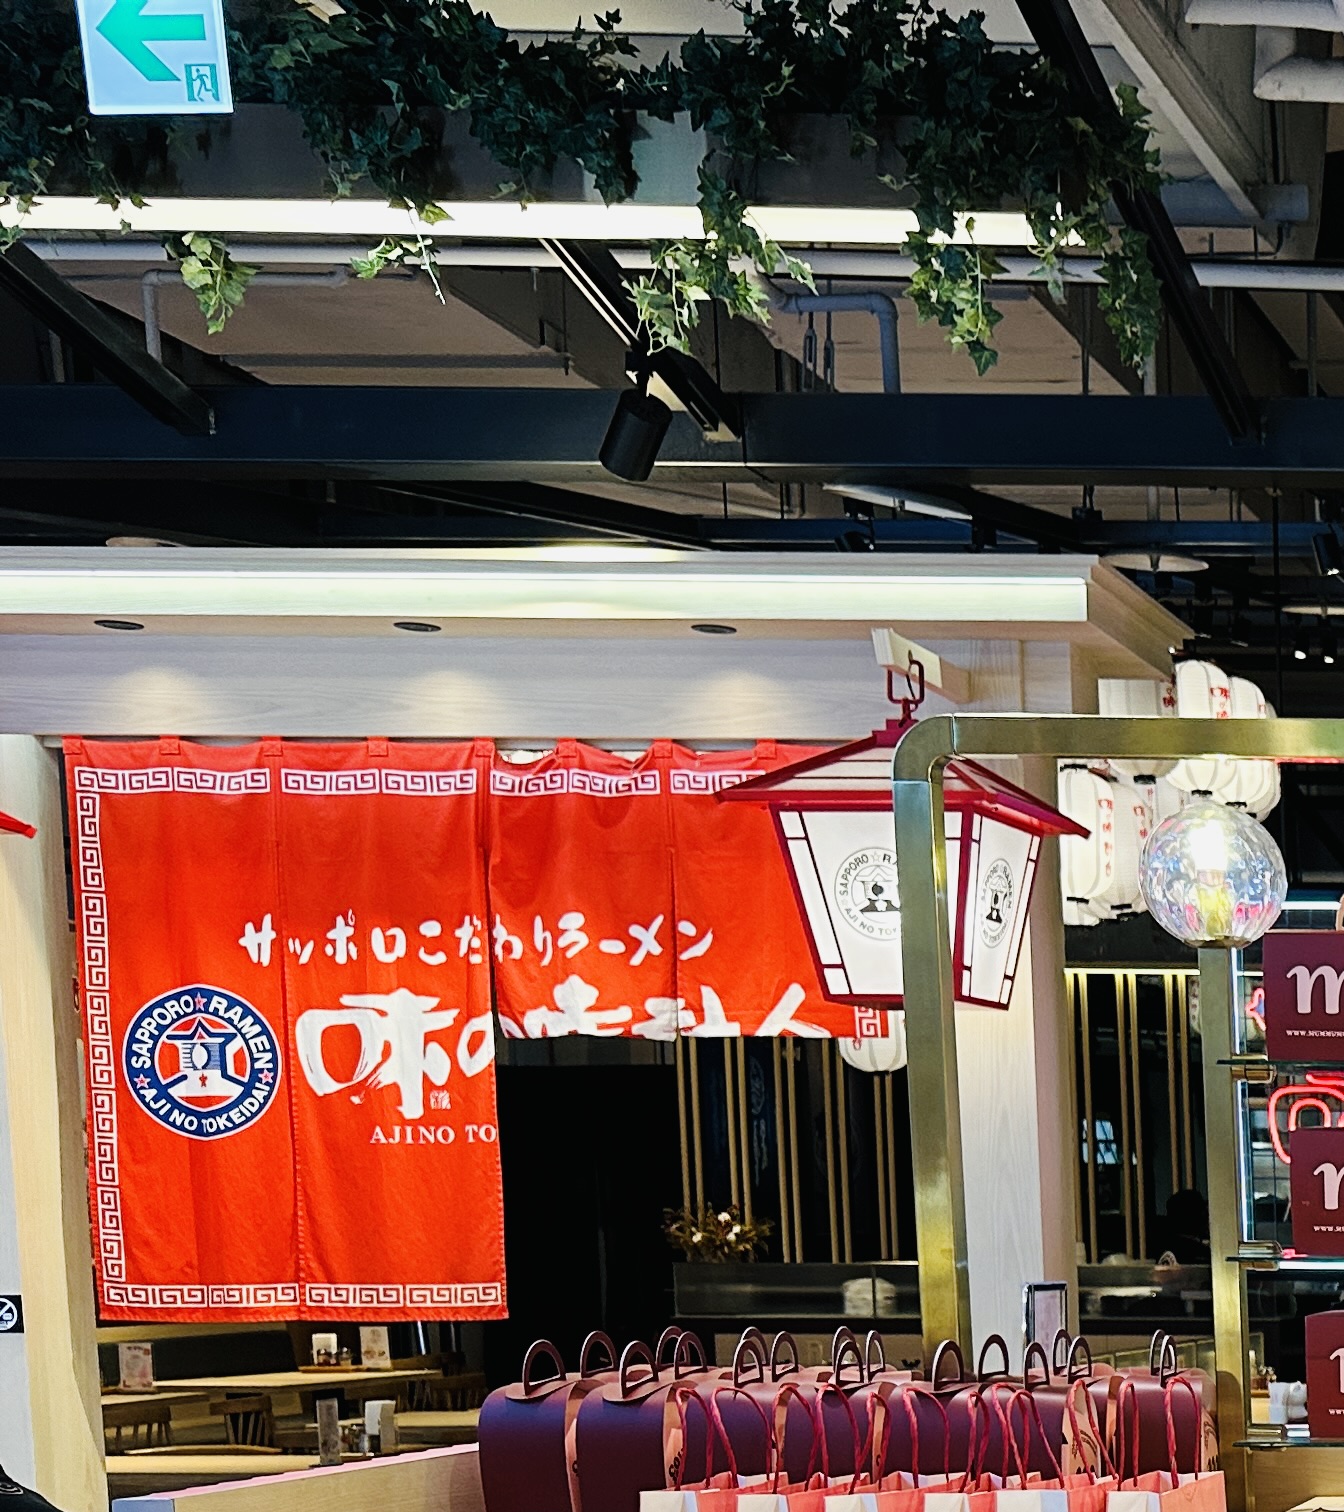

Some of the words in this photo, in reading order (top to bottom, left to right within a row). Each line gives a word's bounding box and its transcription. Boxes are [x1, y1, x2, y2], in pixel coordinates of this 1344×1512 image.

[131, 996, 195, 1070] SAPPORO
[208, 996, 274, 1070] RAMEN
[140, 1087, 170, 1116] AJI
[169, 1109, 198, 1132] NO
[201, 1083, 272, 1134] TOKEIDAI
